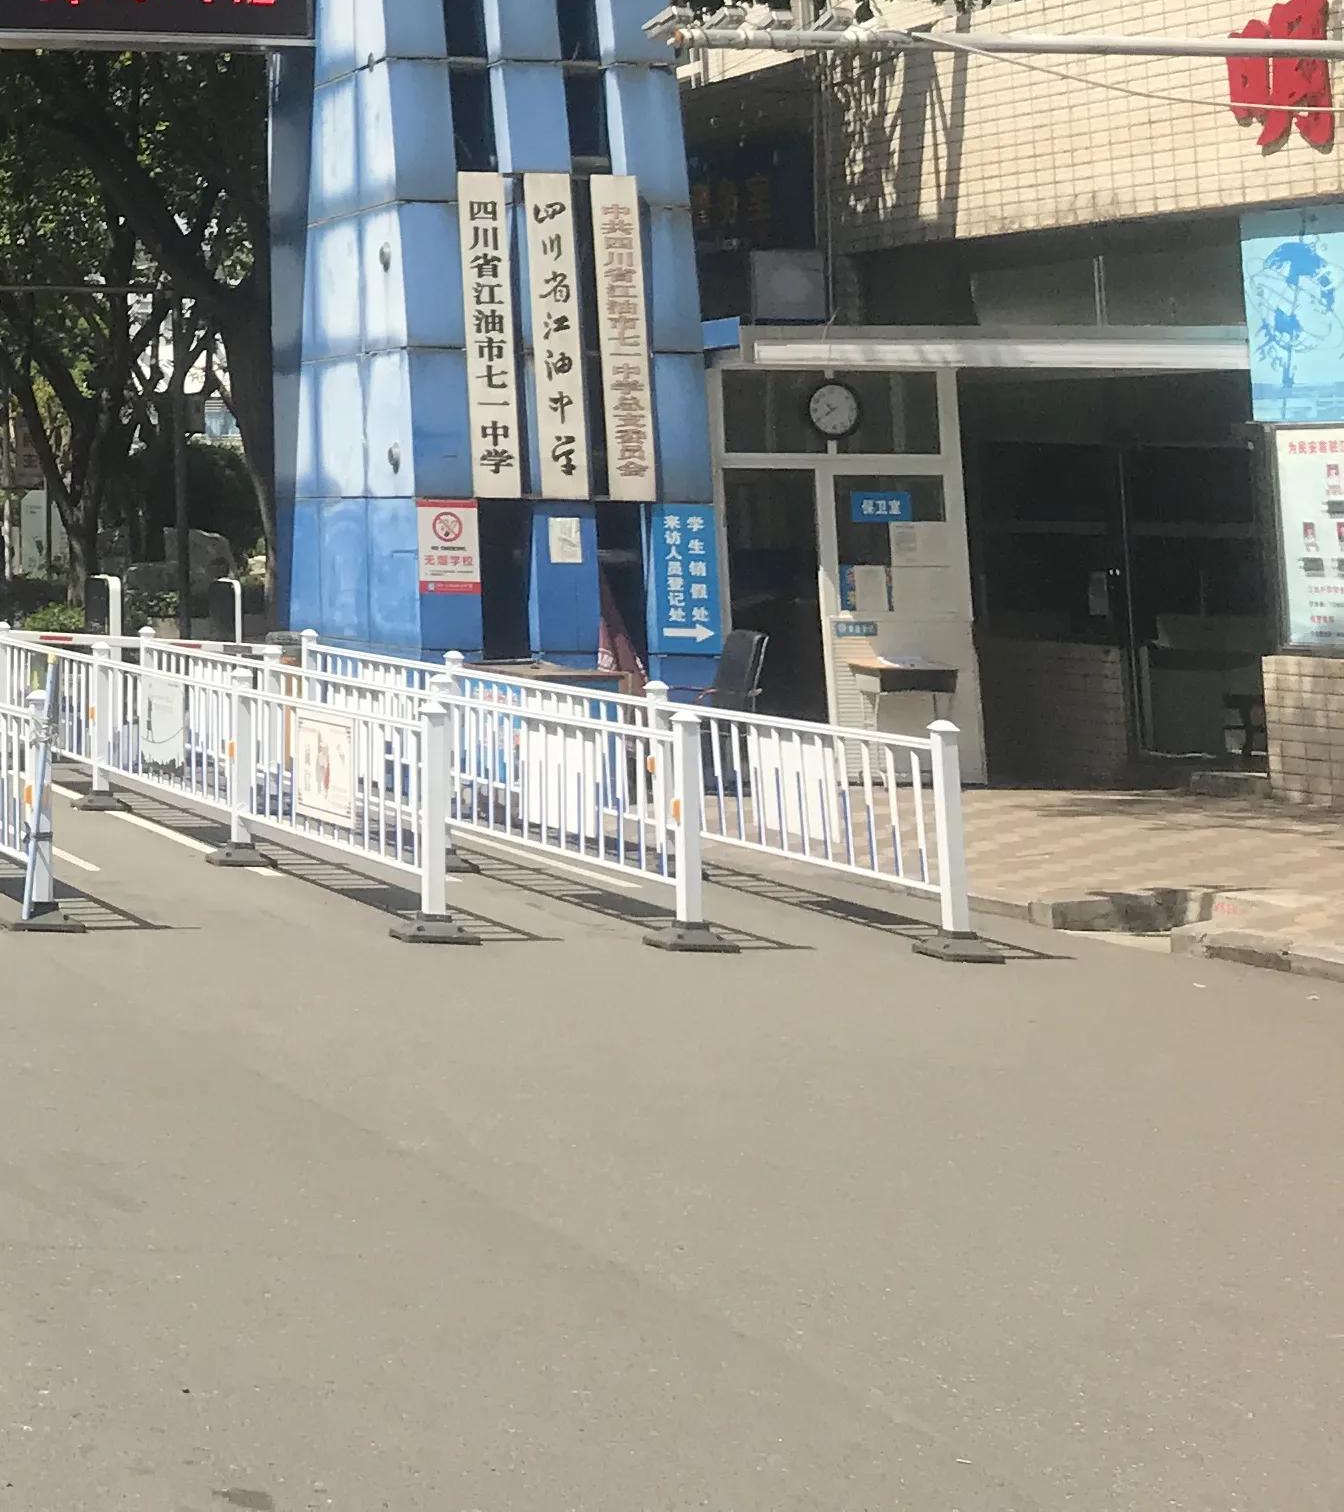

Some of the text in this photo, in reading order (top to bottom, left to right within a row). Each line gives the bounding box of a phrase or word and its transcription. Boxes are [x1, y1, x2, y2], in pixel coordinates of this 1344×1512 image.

[467, 199, 516, 475] 四川省江油市七一中学
[532, 200, 578, 478] 四川省江油中学
[600, 202, 650, 479] 中共四川省江油市七一中学总支委员会
[423, 554, 475, 567] 无烟学校
[861, 498, 902, 515] 保卫室
[663, 514, 687, 622] 来访人员登记处
[686, 515, 710, 622] 学生销假处
